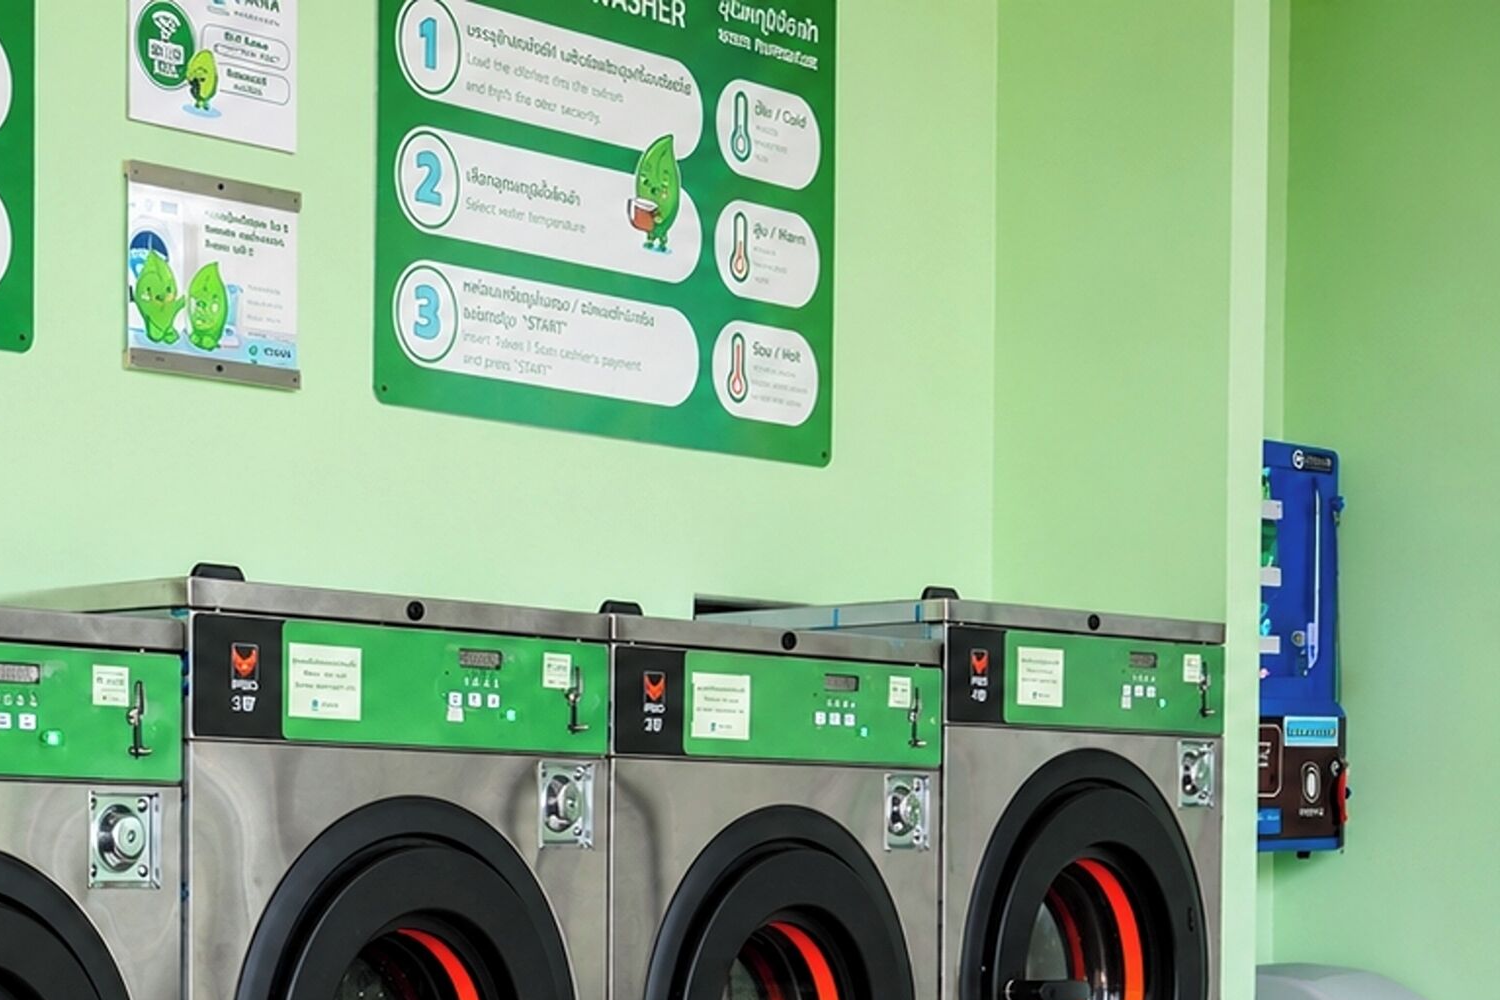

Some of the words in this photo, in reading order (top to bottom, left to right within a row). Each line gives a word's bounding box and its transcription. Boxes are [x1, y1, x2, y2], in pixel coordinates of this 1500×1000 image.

[418, 16, 438, 71] 1
[414, 150, 442, 206] 2
[413, 284, 441, 340] 3
